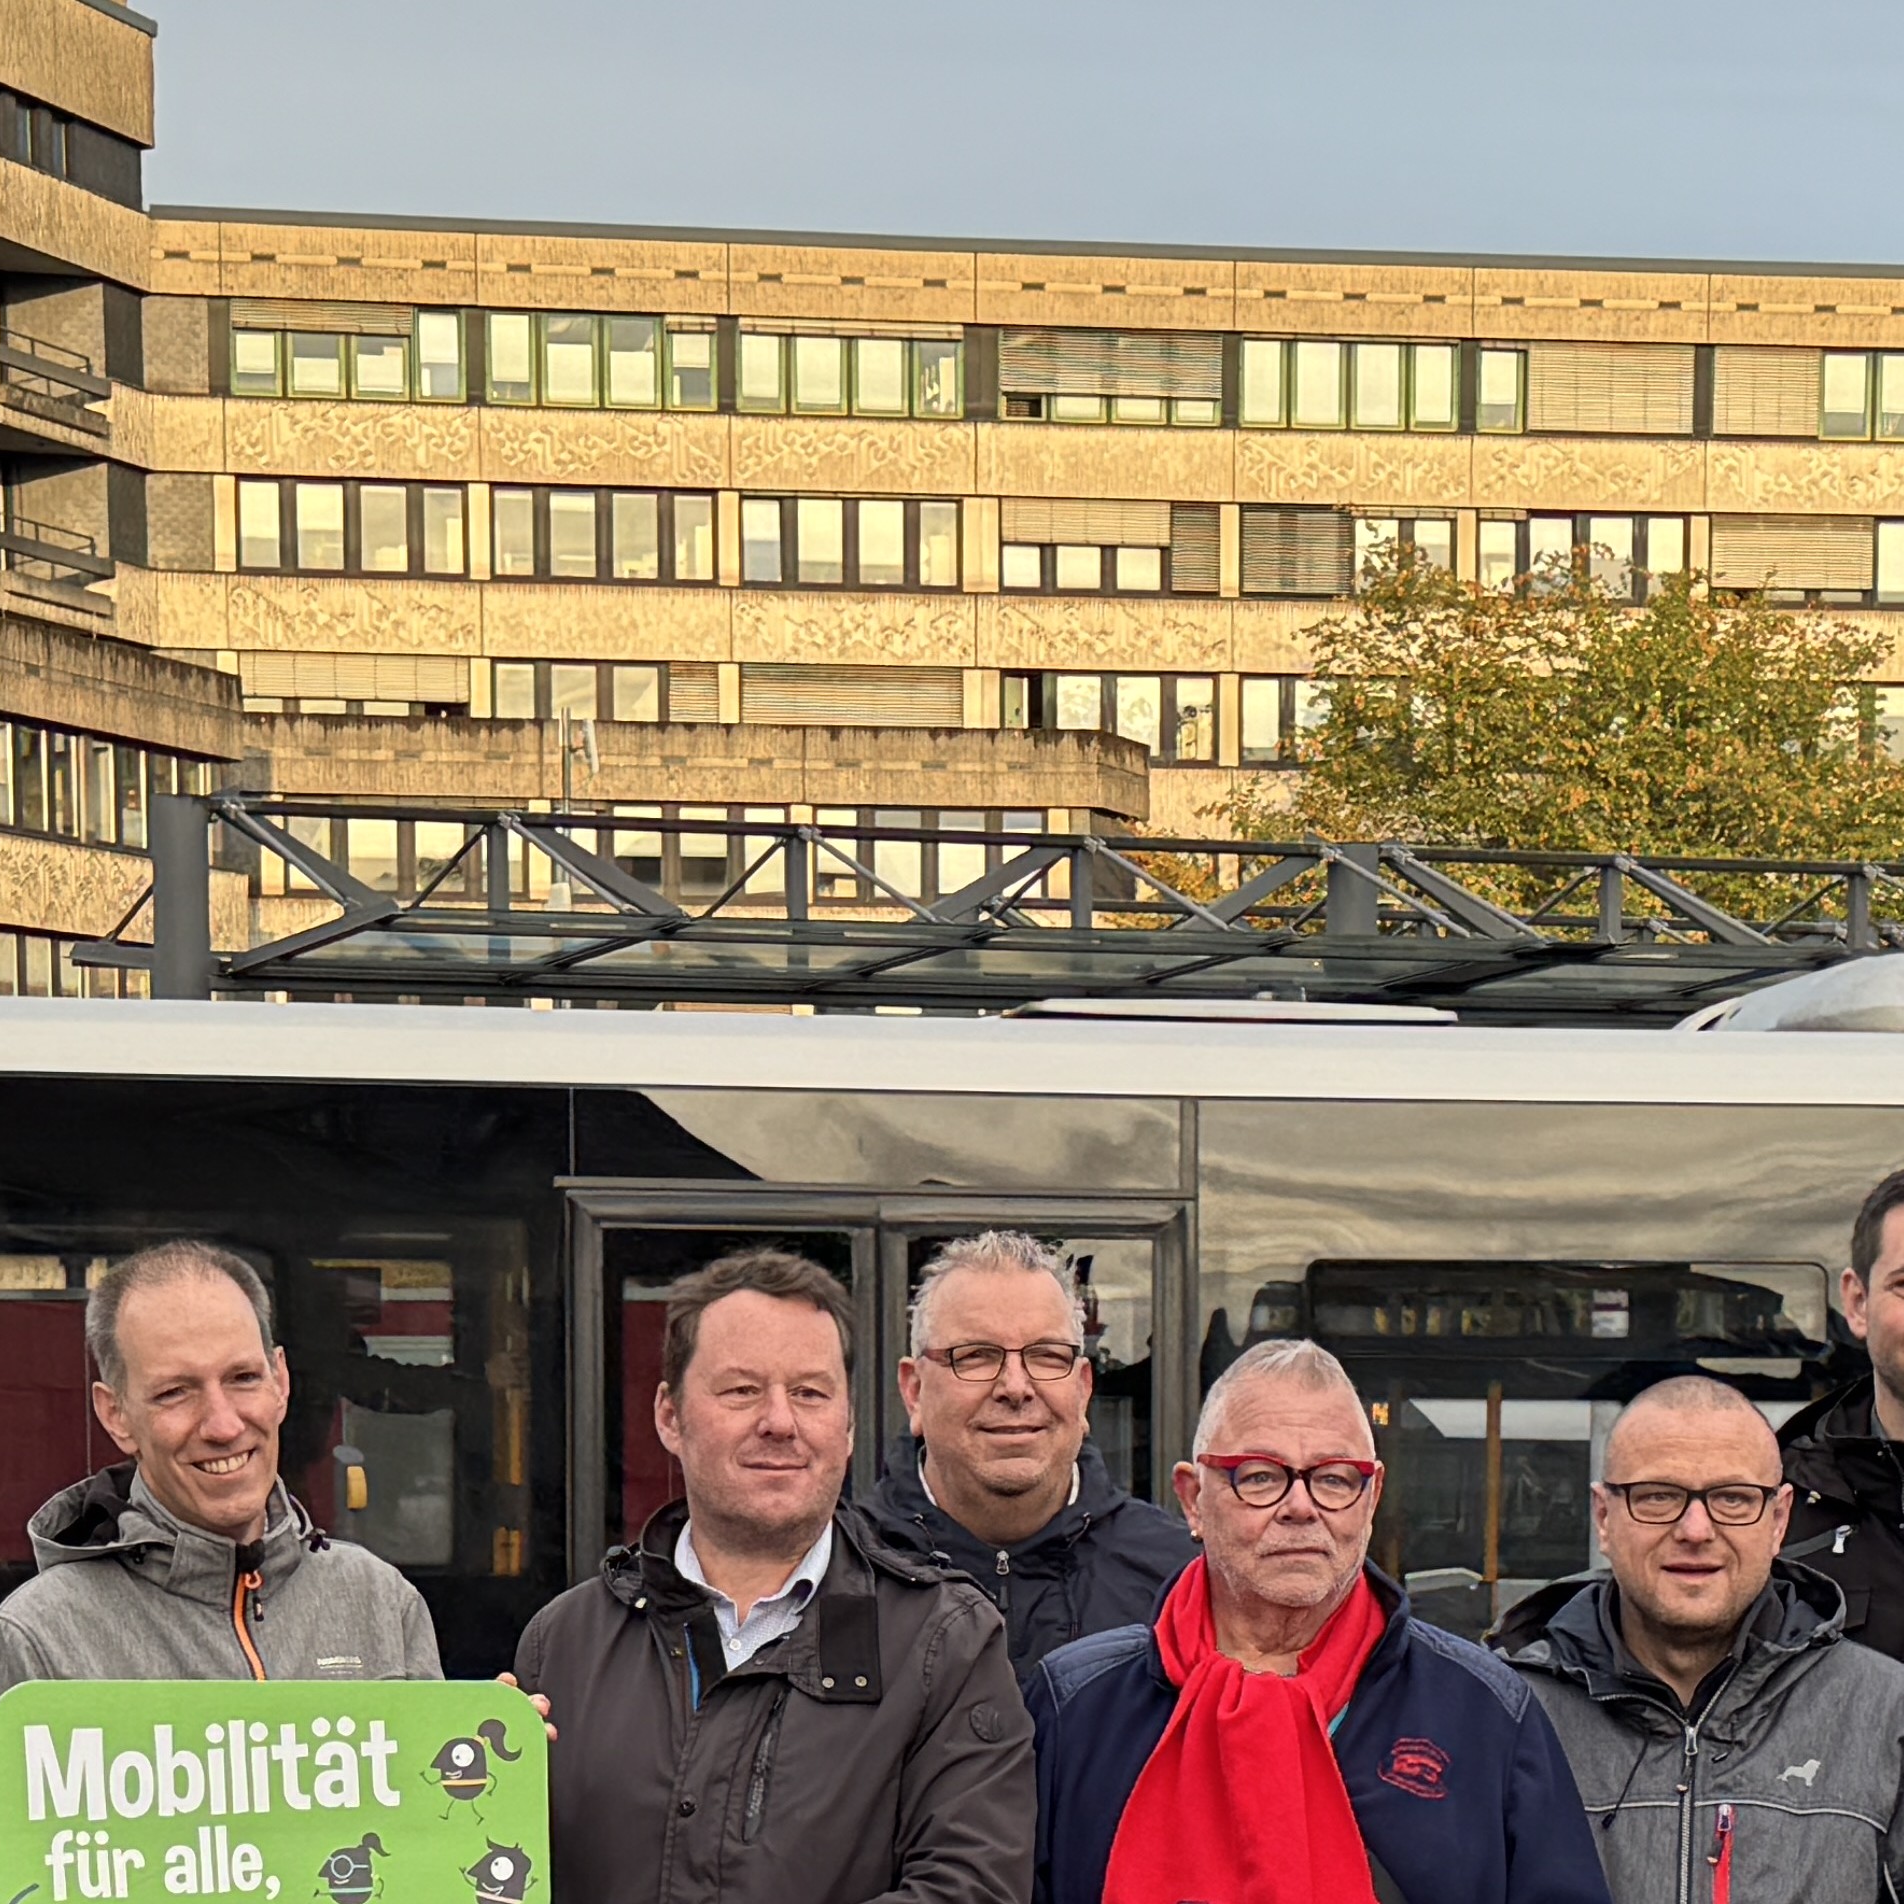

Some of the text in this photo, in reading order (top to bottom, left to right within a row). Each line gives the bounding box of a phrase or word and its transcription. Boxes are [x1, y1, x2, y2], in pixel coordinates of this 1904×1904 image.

[22, 1715, 401, 1822] Mobilität
[44, 1824, 283, 1902] für alle,
